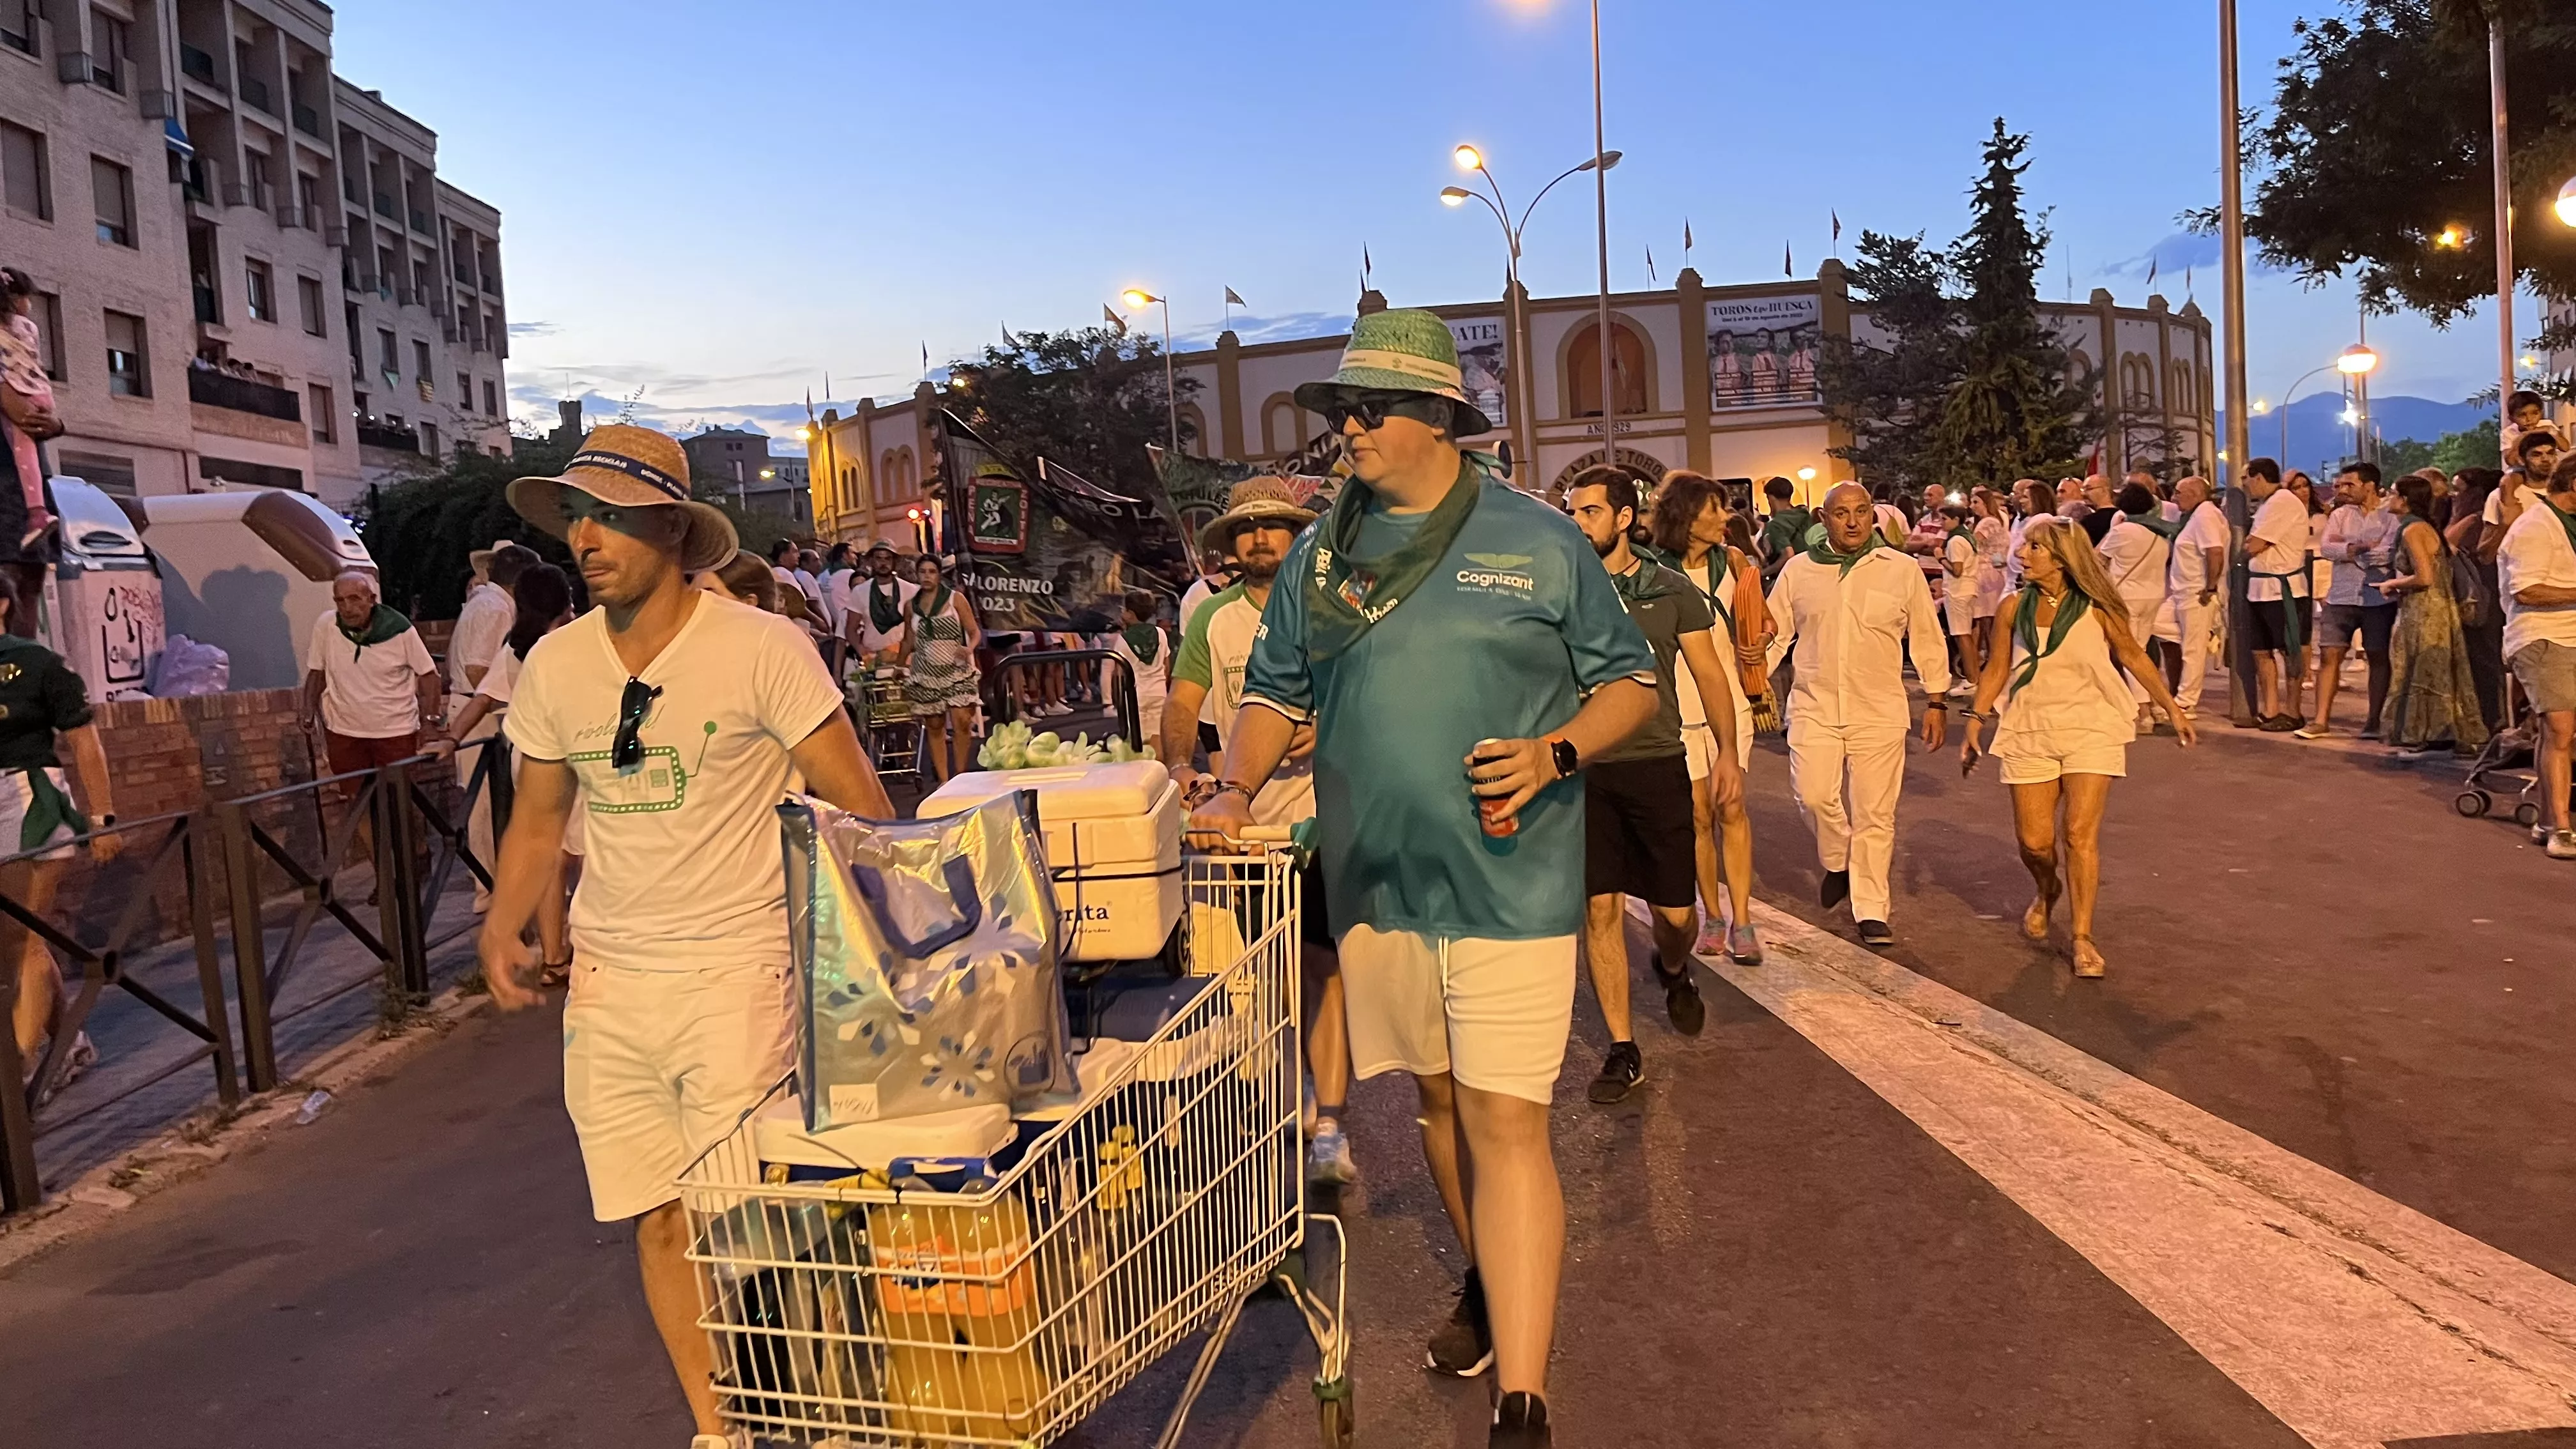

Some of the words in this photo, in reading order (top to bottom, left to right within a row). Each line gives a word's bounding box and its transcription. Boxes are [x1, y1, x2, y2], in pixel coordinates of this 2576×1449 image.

[1712, 304, 1752, 316] TOROS
[1768, 301, 1813, 312] HUESCA
[1452, 324, 1498, 341] ATE!
[1627, 451, 1663, 476] TORO
[977, 576, 1054, 595] LORENZO
[1457, 571, 1533, 591] Cognizant
[979, 597, 1016, 612] 023
